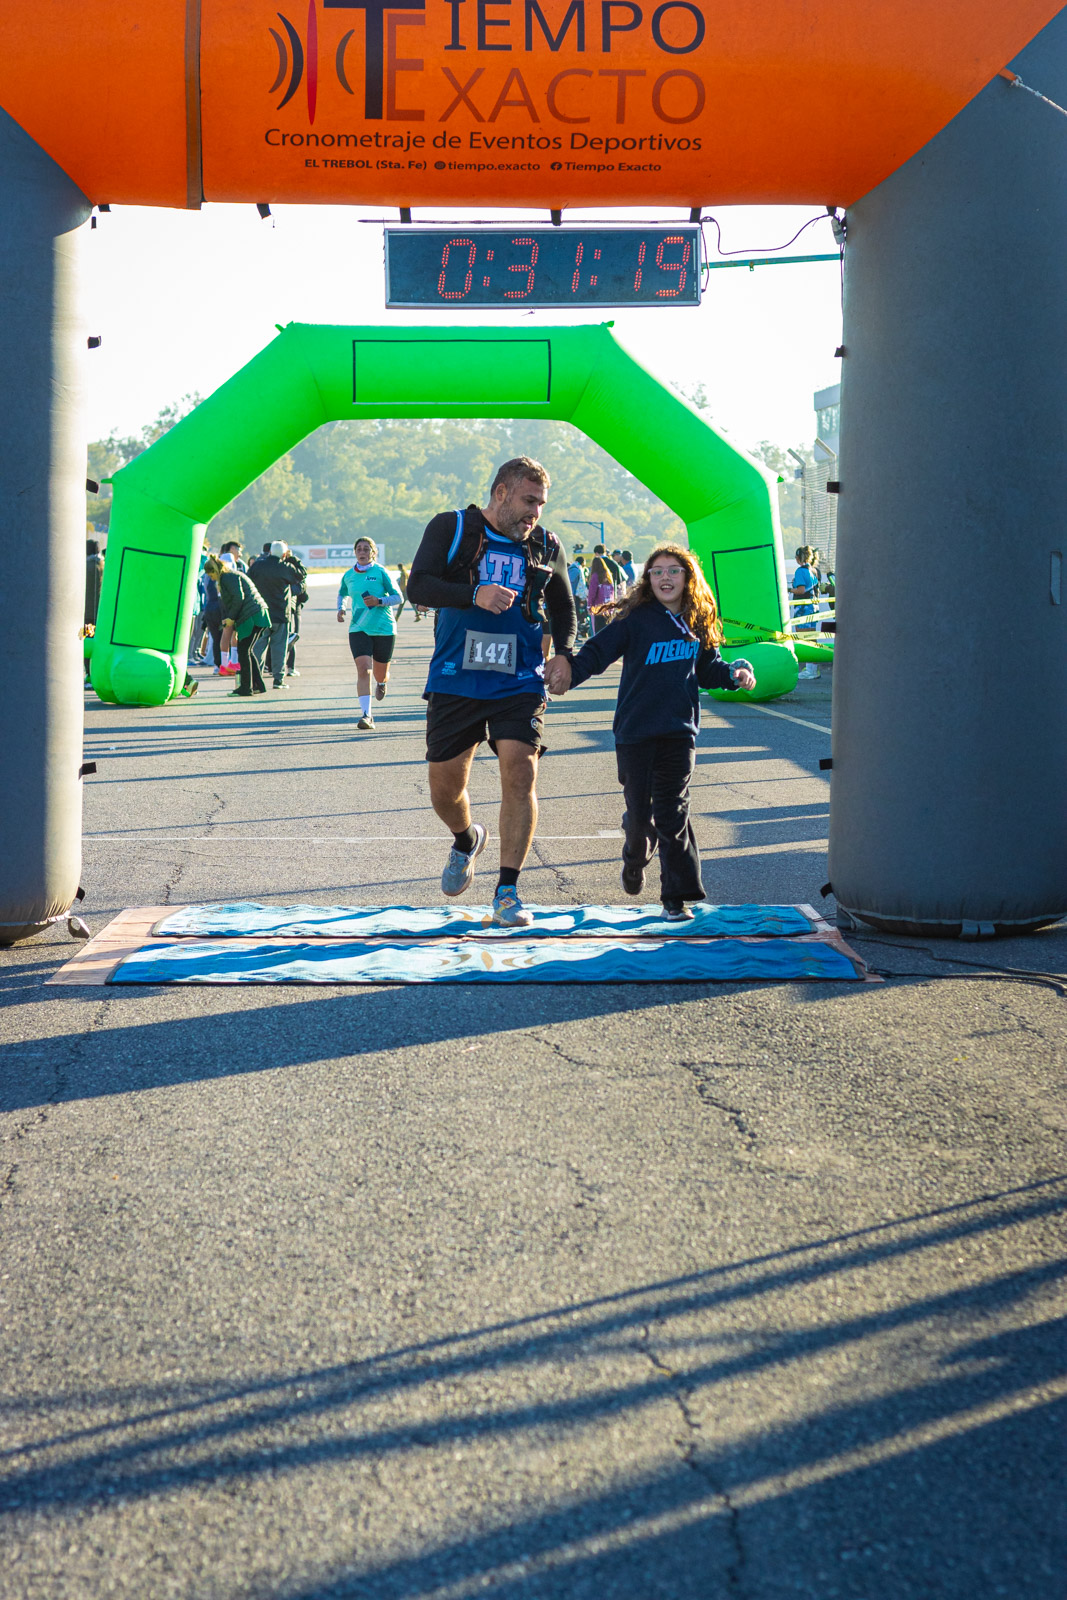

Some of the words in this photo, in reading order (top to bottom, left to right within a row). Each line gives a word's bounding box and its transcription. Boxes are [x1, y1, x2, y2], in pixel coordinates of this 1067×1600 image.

[264, 128, 426, 153] Cronometraje
[432, 130, 462, 149] de
[469, 131, 563, 150] Eventos
[570, 132, 702, 155] Deportivos
[304, 158, 320, 168] EL
[322, 159, 373, 169] TREBOL
[375, 159, 405, 170] (Sta.
[407, 160, 427, 171] Fe)
[447, 161, 541, 173] tiempo.exacto
[564, 161, 615, 173] Tiempo
[617, 162, 662, 172] Exacto
[474, 641, 508, 665] 147
